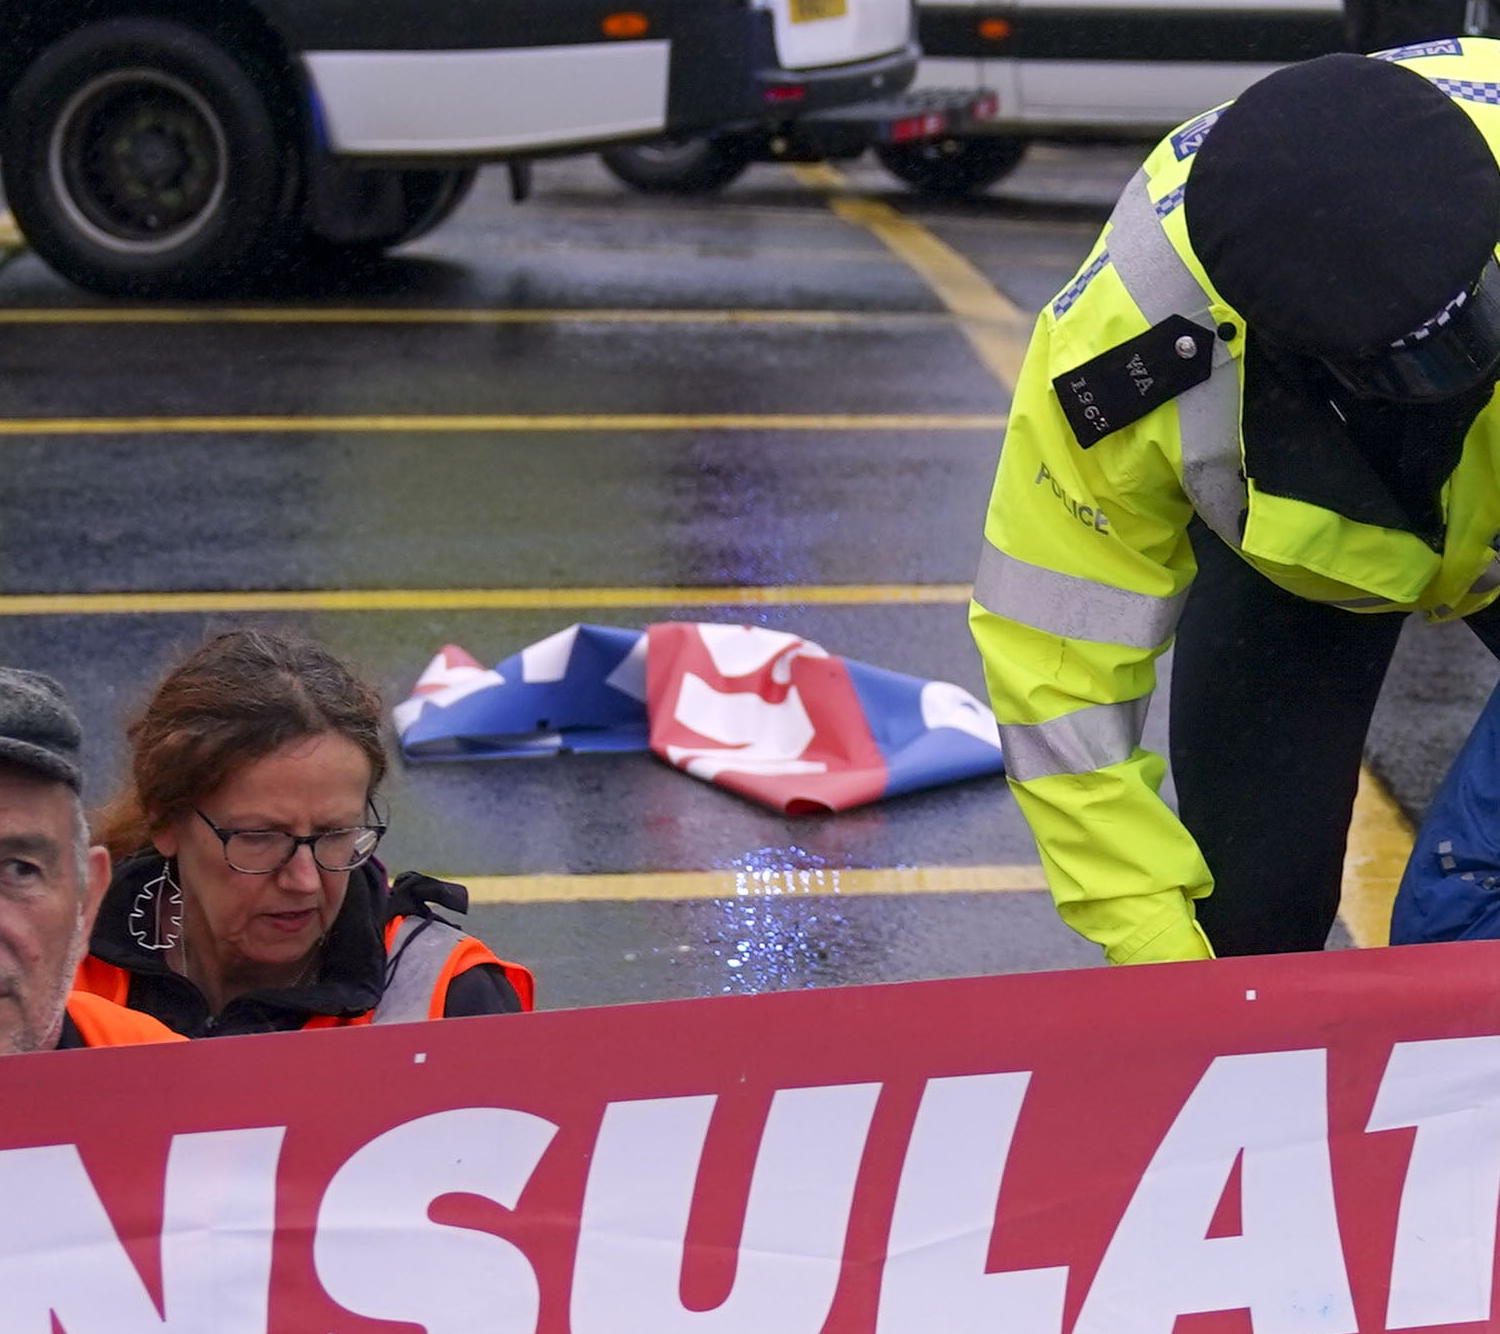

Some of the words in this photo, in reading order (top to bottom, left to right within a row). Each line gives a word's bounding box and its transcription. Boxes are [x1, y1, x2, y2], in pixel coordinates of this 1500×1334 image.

[1125, 353, 1154, 396] WA
[1070, 377, 1109, 431] 1963
[1035, 462, 1109, 535] POLICE
